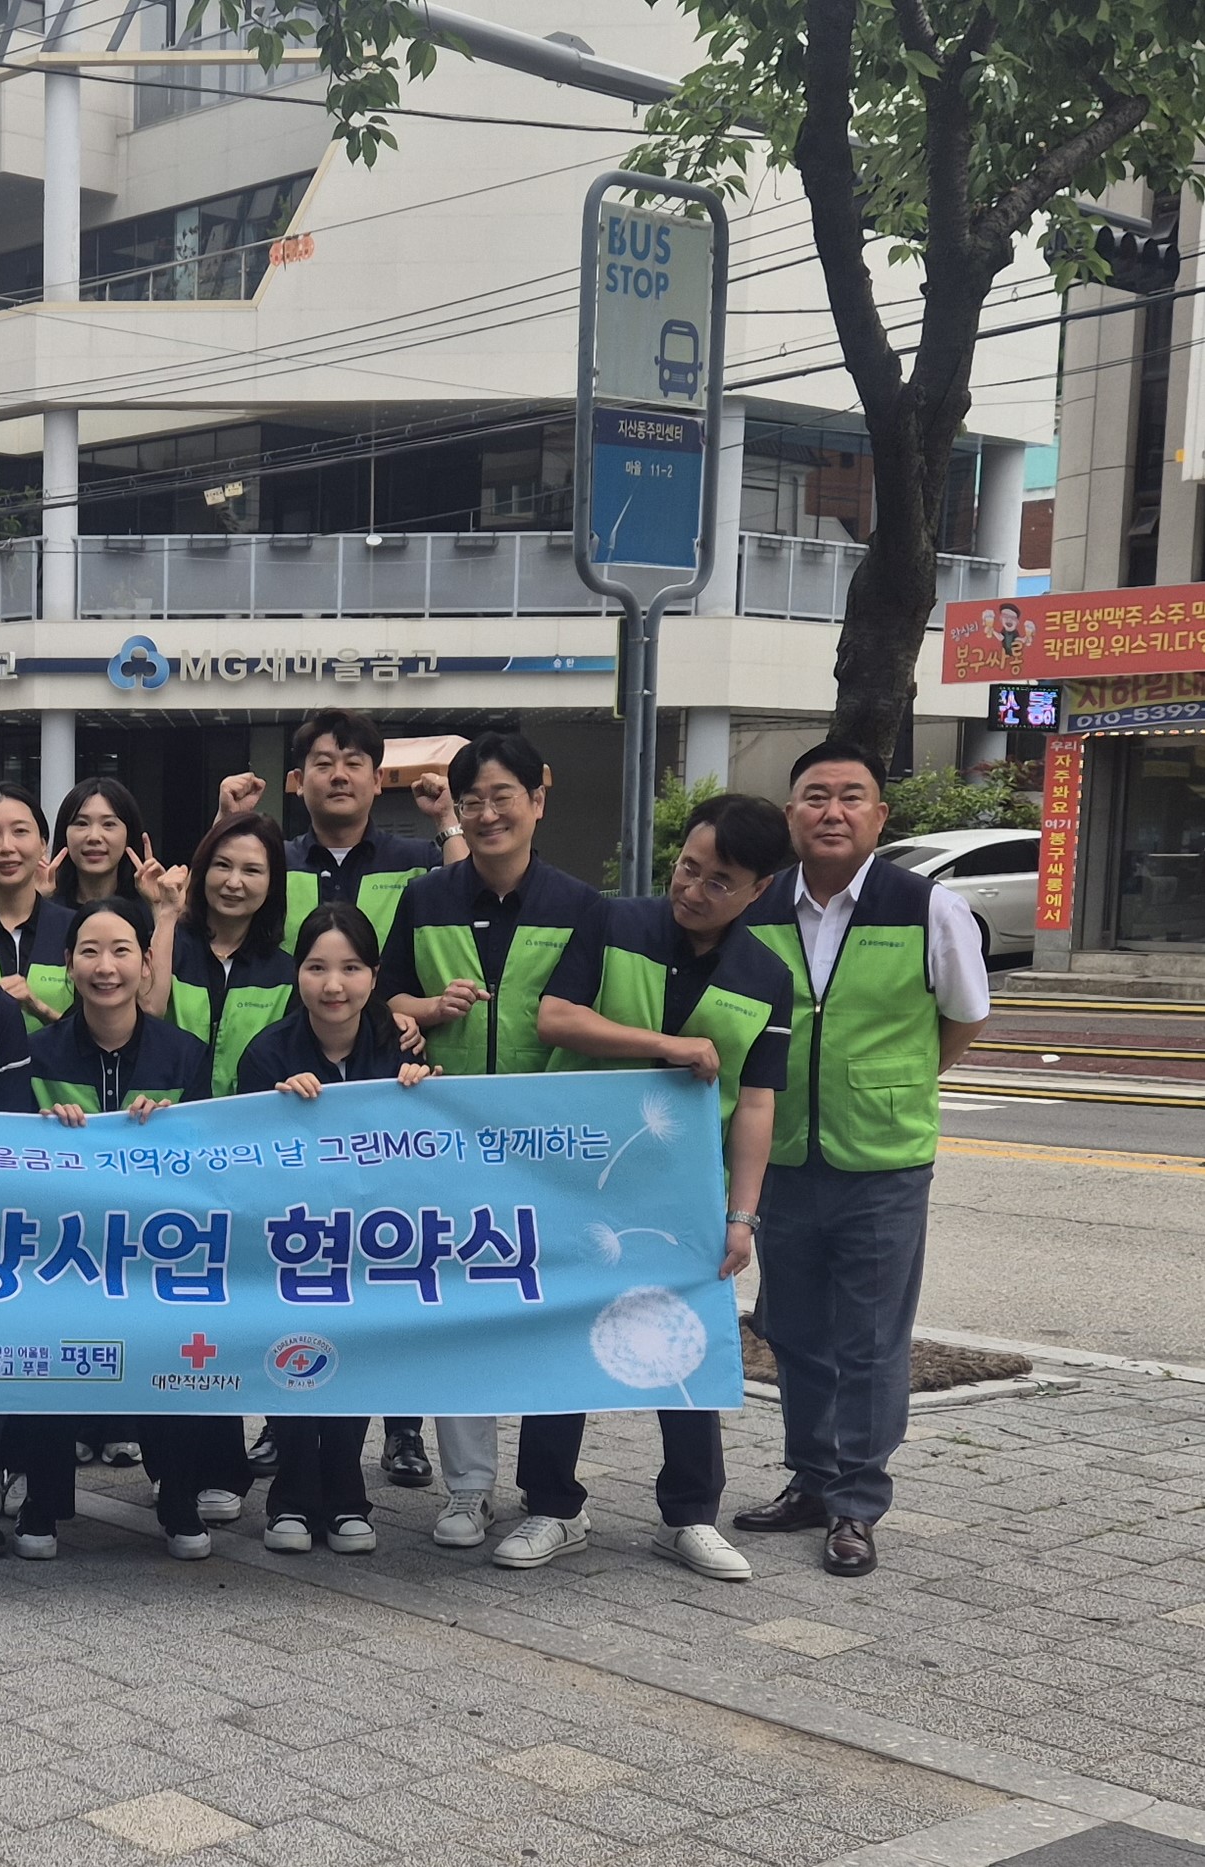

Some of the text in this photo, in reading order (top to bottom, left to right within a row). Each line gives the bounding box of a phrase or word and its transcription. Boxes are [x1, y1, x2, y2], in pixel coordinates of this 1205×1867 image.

[608, 216, 671, 265] BUS
[605, 262, 669, 300] STOP
[618, 418, 683, 443] 지산동주민센터
[625, 460, 673, 478] 마을 11-2
[179, 647, 441, 682] MG새마을금고
[955, 641, 1024, 679] 봉구싸롱
[1050, 740, 1077, 751] 우리
[1050, 754, 1073, 814] 자주봐요
[1044, 819, 1072, 830] 여기
[1043, 832, 1067, 923] 봉구싸롱에서
[97, 1143, 263, 1176] 지역상생의
[274, 1138, 305, 1168] 날
[319, 1129, 466, 1166] 그린MG가
[478, 1125, 610, 1164] 함께하는
[266, 1203, 542, 1304] 협약식
[61, 1346, 117, 1376] 평택
[273, 1338, 298, 1354] KOREAN
[312, 1338, 333, 1354] CROSS
[22, 1361, 49, 1376] 푸른
[152, 1374, 241, 1391] 대한적십자사
